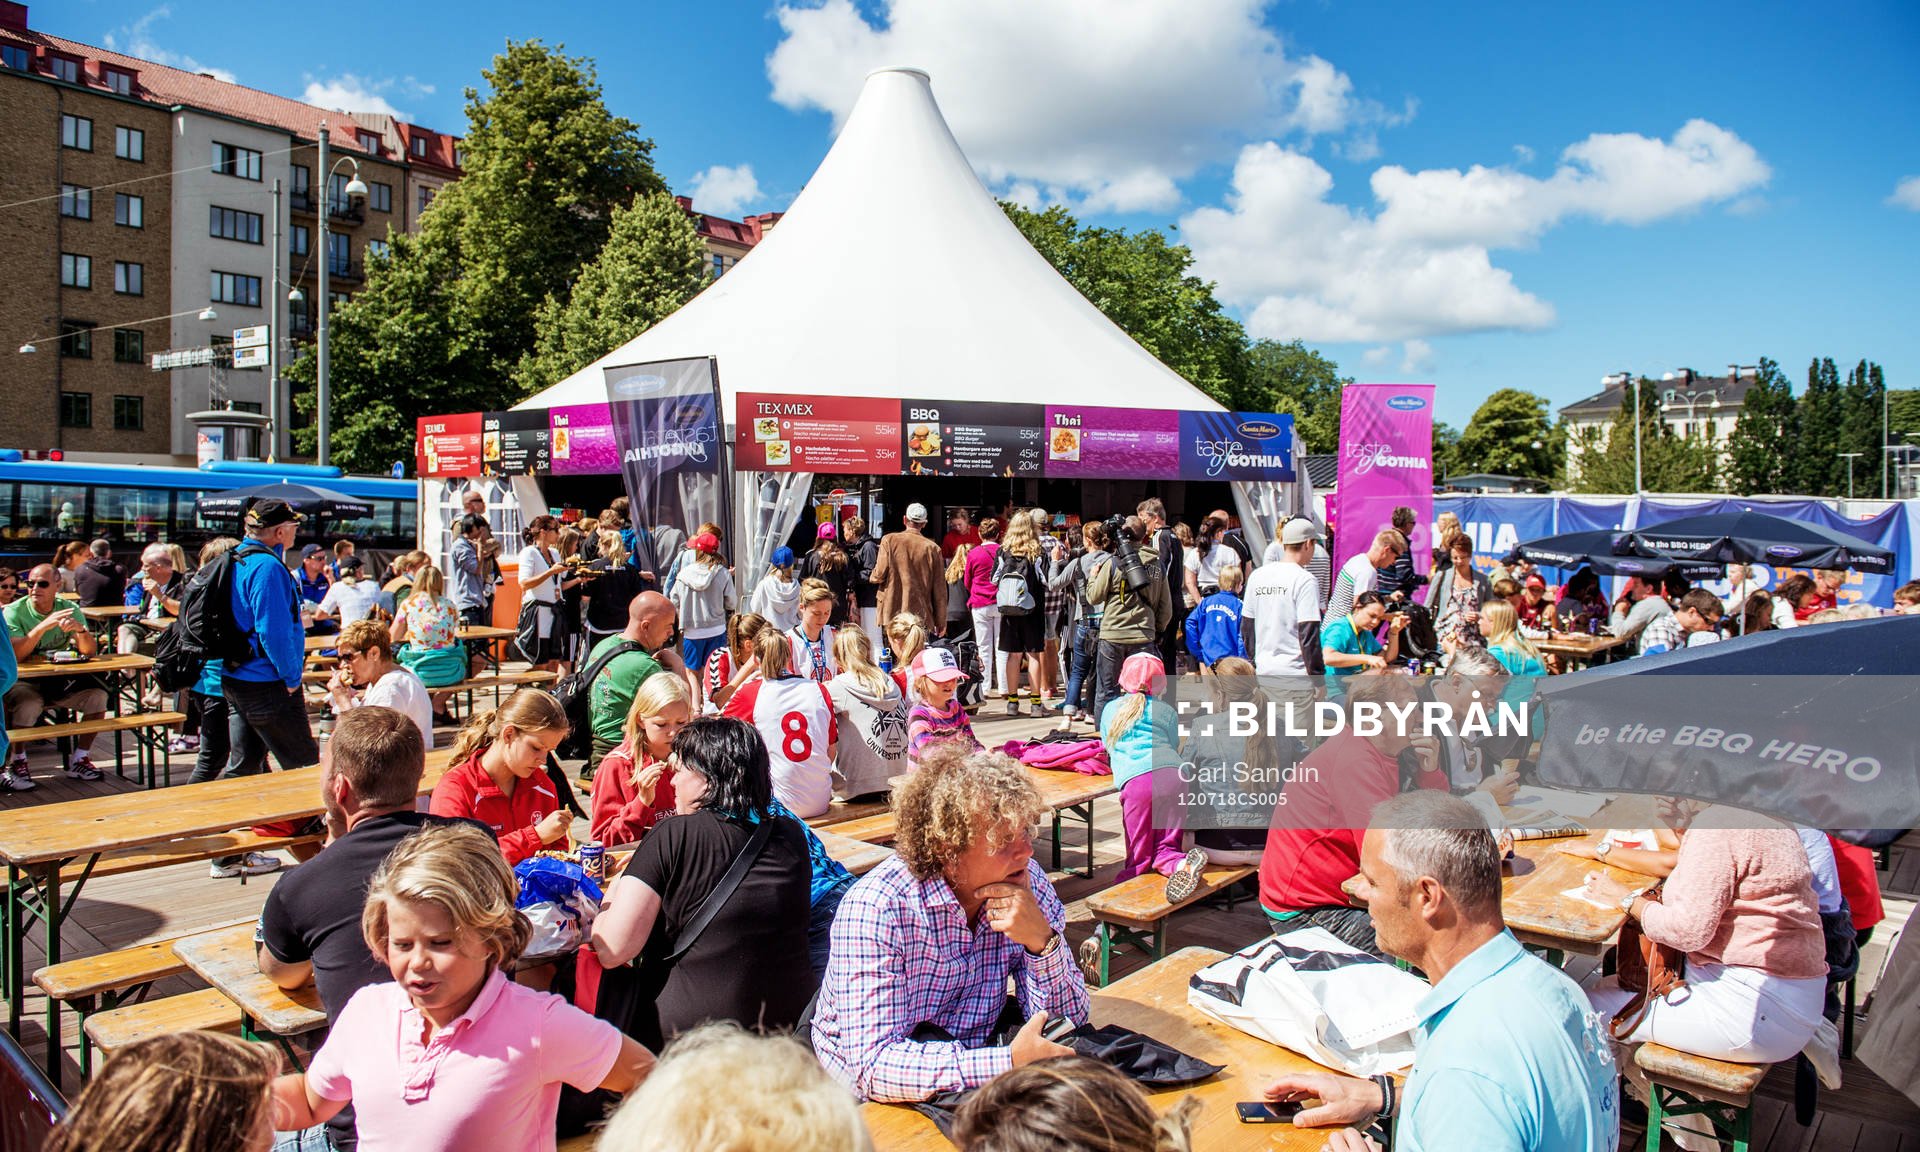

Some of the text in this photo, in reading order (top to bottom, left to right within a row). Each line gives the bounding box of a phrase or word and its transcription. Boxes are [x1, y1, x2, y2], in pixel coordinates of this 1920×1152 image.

[756, 402, 813, 416] TEX MEX
[910, 408, 939, 420] BBQ
[554, 414, 569, 427] Thai
[1054, 413, 1081, 426] Thai
[875, 425, 896, 435] 55kr
[1019, 429, 1040, 439] 55kr
[1242, 425, 1277, 433] Santa Maria
[1195, 435, 1243, 457] taste
[1345, 440, 1393, 458] taste
[875, 449, 897, 459] 35kr
[1019, 449, 1040, 458] 45kr
[1018, 461, 1040, 471] 20kr
[1227, 455, 1283, 469] GOTHIA
[1376, 456, 1428, 470] GOTHIA
[1643, 540, 1712, 551] be the BBQ HERO
[1255, 586, 1288, 597] SECURITY
[781, 711, 812, 762] 8
[866, 737, 901, 761] UNIVERSITY
[1575, 723, 1881, 783] be the BBQ HERO
[654, 809, 678, 821] TEAM
